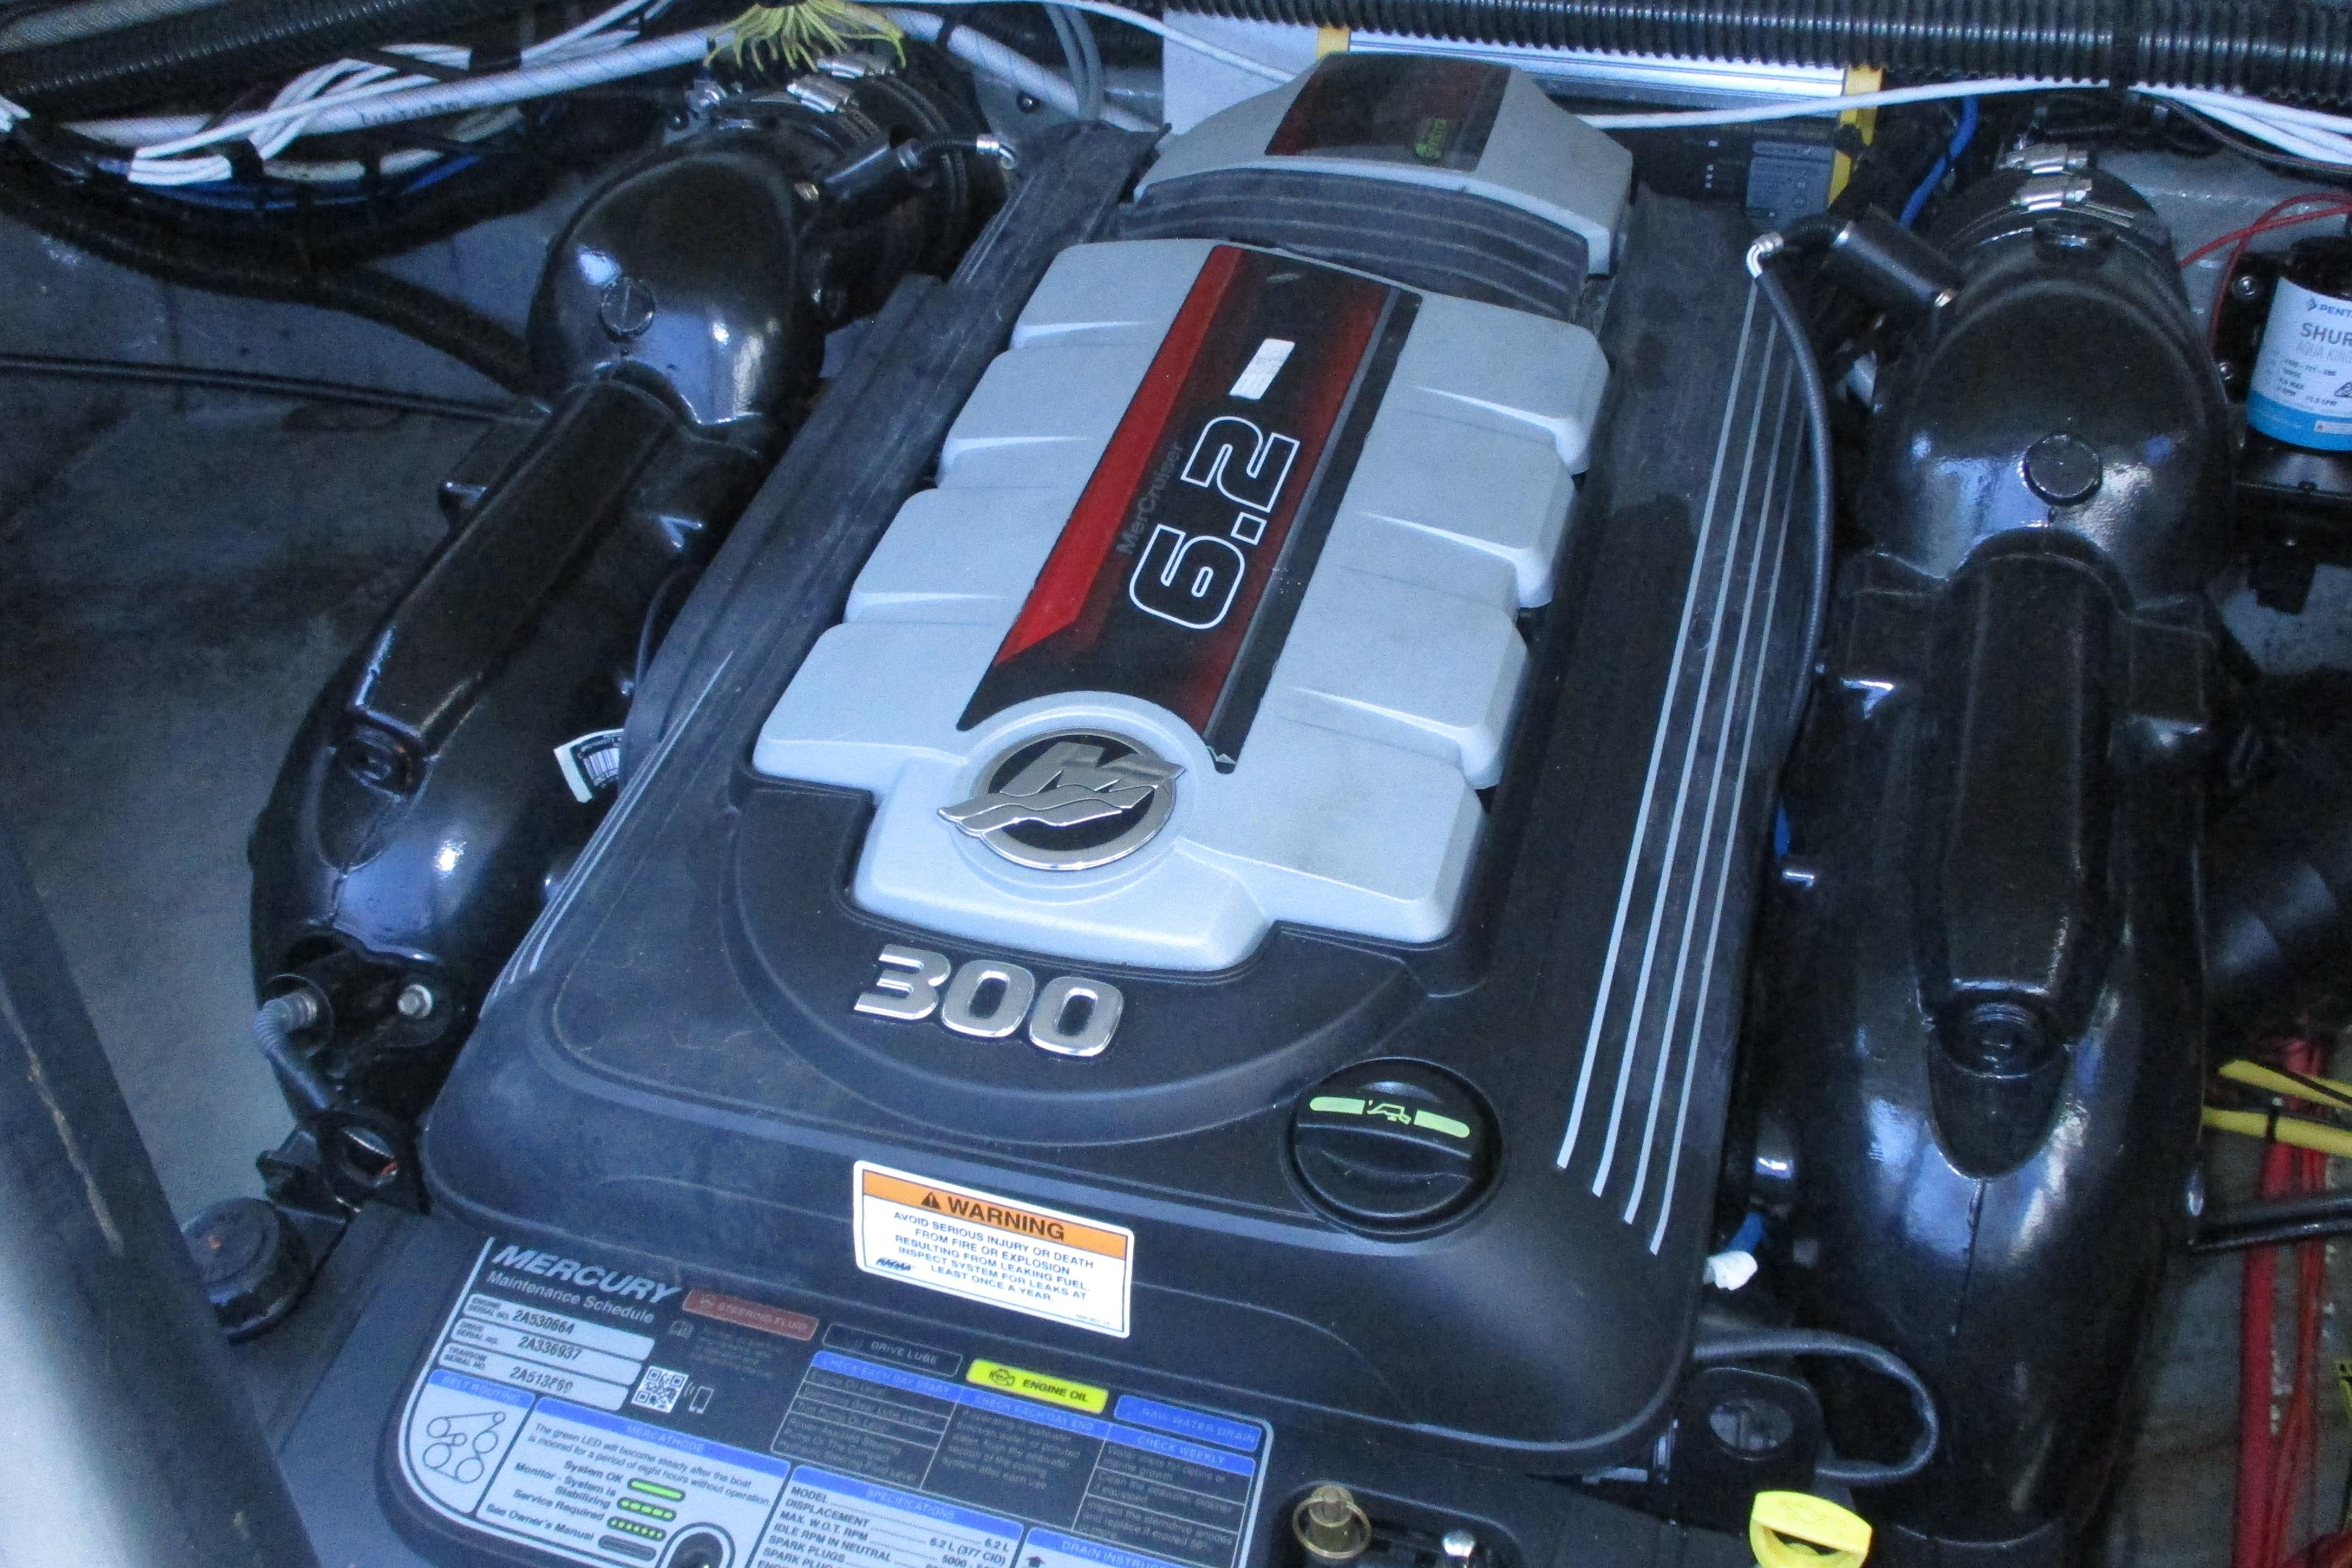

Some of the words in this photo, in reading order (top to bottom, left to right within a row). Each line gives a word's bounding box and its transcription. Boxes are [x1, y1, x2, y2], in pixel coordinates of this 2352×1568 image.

[1115, 441, 1182, 555] MerCruiser
[1129, 416, 1300, 629] 6.2
[854, 943, 1125, 1057] 300
[948, 1195, 1064, 1241] WARNING
[894, 1211, 928, 1227] AVOID
[932, 1220, 983, 1242] SERIOUS
[987, 1234, 1028, 1253] INJURY
[1033, 1246, 1049, 1258] OR
[1054, 1251, 1093, 1270] DEATH
[916, 1229, 948, 1245] FROM
[952, 1238, 977, 1252] FIRE
[981, 1245, 997, 1257] OR
[1002, 1250, 1070, 1276] EXPLOSION
[492, 1244, 682, 1304] MERCURY
[895, 1234, 959, 1258] RESULTING
[963, 1251, 996, 1268] FROM
[1001, 1261, 1052, 1282] LEAKING
[1057, 1275, 1089, 1292] FUEL.
[899, 1245, 946, 1265] INSPECT
[951, 1259, 997, 1278] SYSTEM
[1002, 1272, 1025, 1285] FOR
[1029, 1279, 1068, 1296] LEAKS
[1073, 1290, 1086, 1301] AT
[486, 1269, 583, 1306] Maintenance
[582, 1293, 657, 1324] Schedule
[931, 1264, 966, 1280] LEAST
[971, 1274, 1003, 1290] ONCE
[1019, 1286, 1054, 1302] YEAR.
[517, 1334, 583, 1362] 2A336937
[870, 1341, 905, 1356] DRIVE
[906, 1350, 938, 1364] LUBE
[1021, 1378, 1067, 1397] ENGINE
[1068, 1390, 1088, 1402] OIL
[527, 1434, 537, 1444] is
[537, 1436, 573, 1454] moored
[572, 1446, 587, 1458] for
[594, 1452, 626, 1468] period
[625, 1460, 637, 1471] of
[636, 1463, 662, 1478] eight
[661, 1469, 690, 1485] hours
[689, 1477, 724, 1494] without
[533, 1423, 553, 1436] The
[552, 1428, 581, 1443] green
[580, 1435, 602, 1449] LED
[602, 1441, 619, 1454] will
[618, 1446, 657, 1464] become
[656, 1455, 689, 1472] steady
[689, 1465, 713, 1479] after
[712, 1471, 730, 1484] the
[729, 1475, 753, 1489] boat
[1136, 1435, 1176, 1453] CHECK
[1179, 1446, 1225, 1465] WEEKLY
[513, 1461, 557, 1481] Monitor
[563, 1474, 605, 1494] System
[605, 1485, 618, 1498] is
[562, 1459, 605, 1479] System
[605, 1470, 624, 1484] OK
[512, 1488, 555, 1509] Service
[553, 1499, 606, 1523] Required
[553, 1485, 612, 1510] Stabilizing
[865, 1488, 956, 1519] SPECIFICATIONS
[485, 1503, 507, 1517] See
[507, 1510, 554, 1530] Owner's
[553, 1521, 596, 1541] Manual
[783, 1498, 871, 1528] DISPLACEMENT
[927, 1537, 947, 1551] 6.2
[956, 1544, 980, 1559] (377
[789, 1485, 828, 1503] MODEL
[983, 1538, 1002, 1550] 6.2
[842, 1527, 870, 1541] RPM
[761, 1547, 800, 1565] SPARK
[767, 1534, 806, 1553] SPARK
[806, 1544, 847, 1563] PLUGS
[773, 1523, 799, 1537] IDLE
[799, 1530, 826, 1545] RPM
[826, 1537, 840, 1548] IN
[840, 1540, 893, 1562] NEUTRAL
[1061, 1540, 1101, 1559] DRAIN
